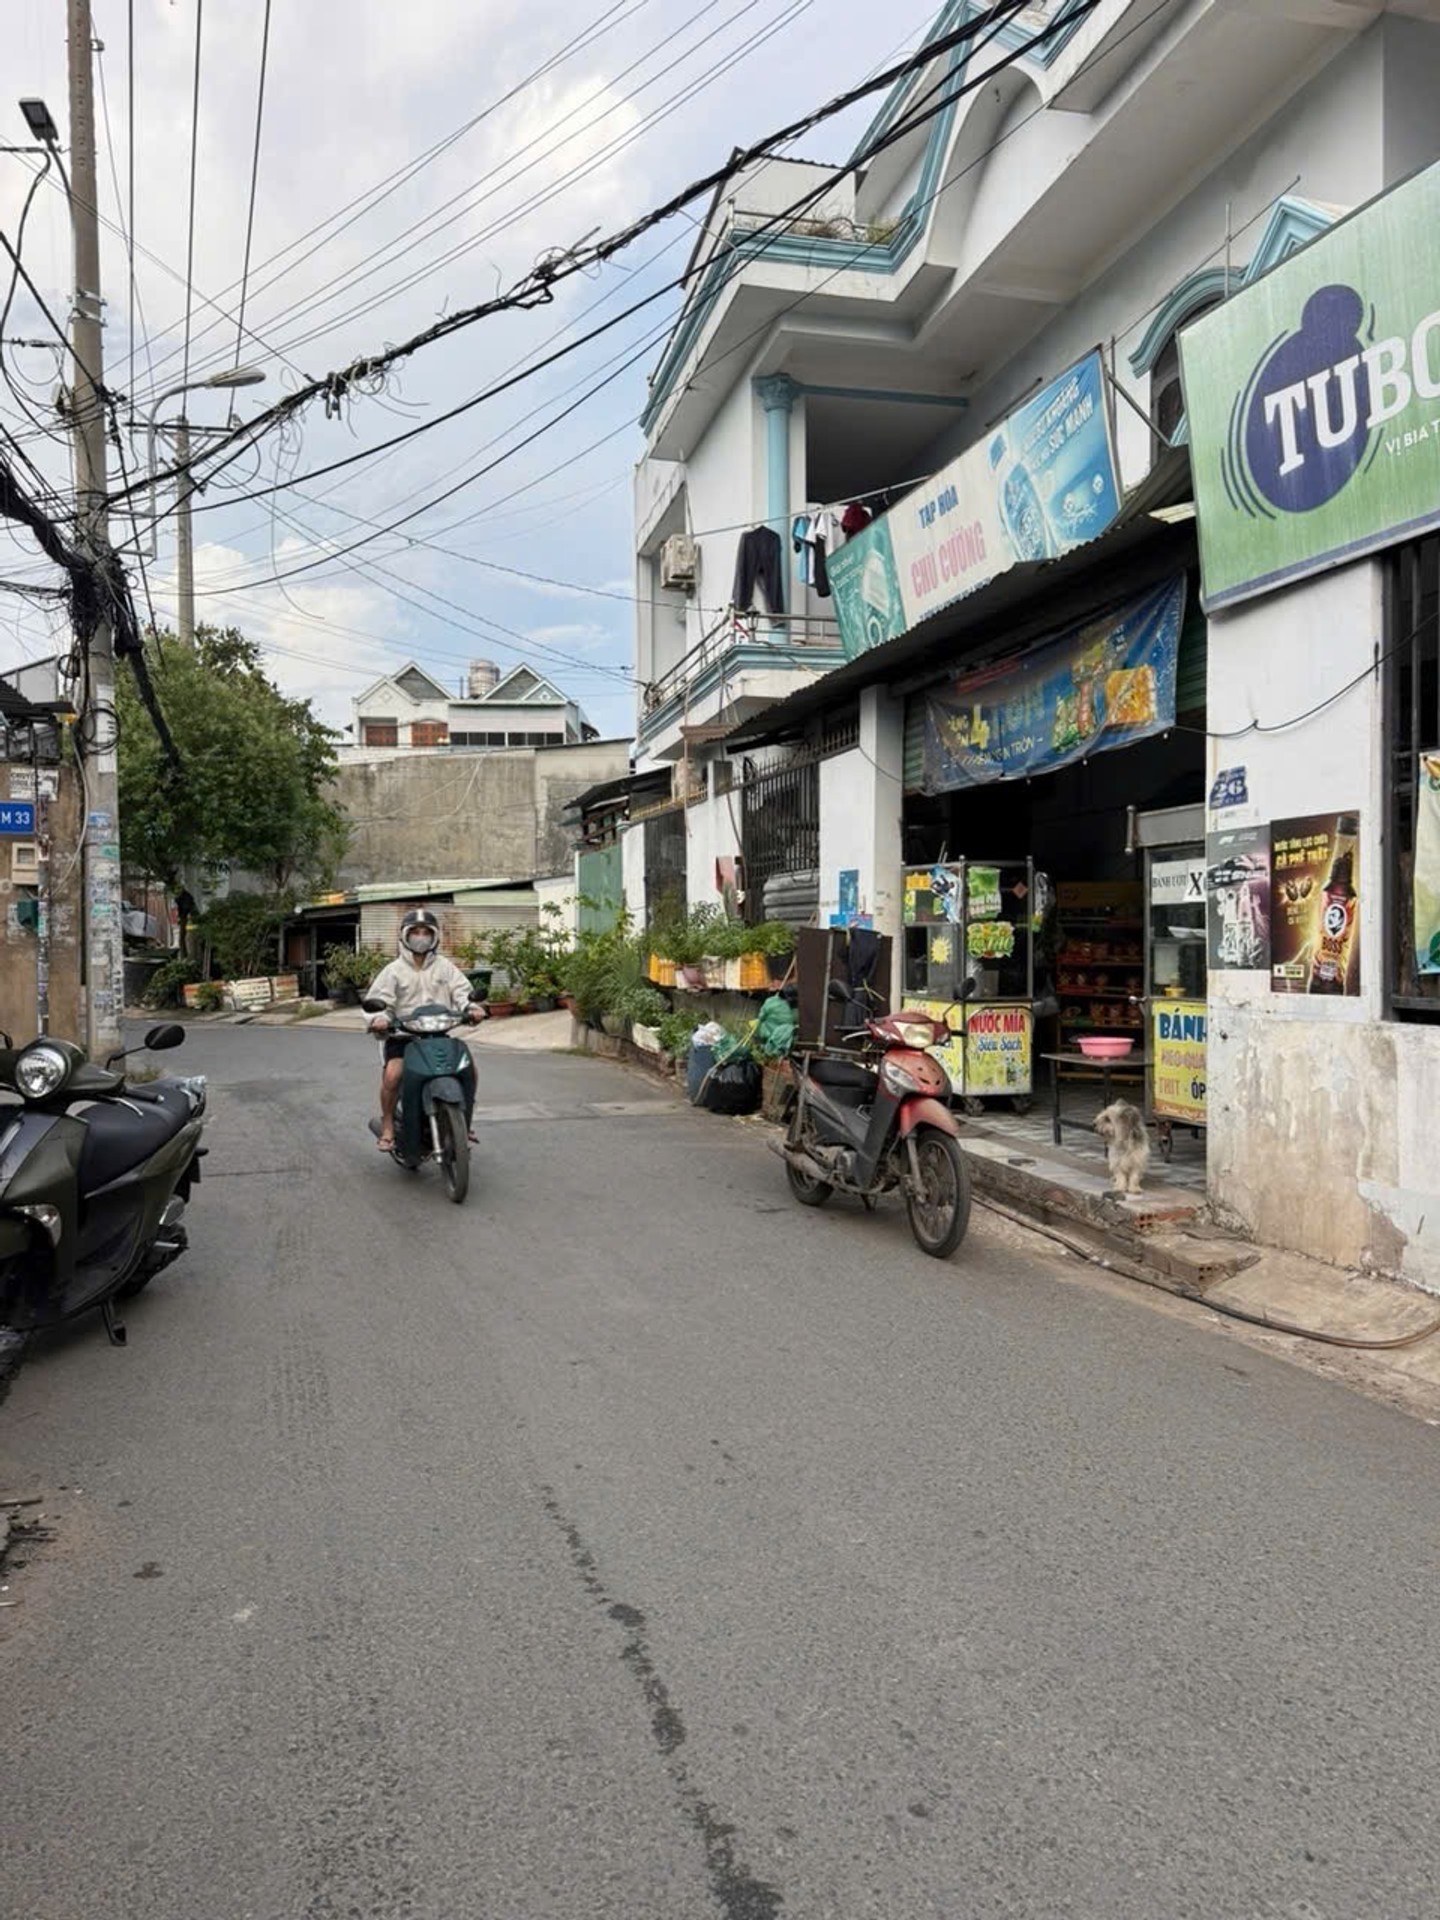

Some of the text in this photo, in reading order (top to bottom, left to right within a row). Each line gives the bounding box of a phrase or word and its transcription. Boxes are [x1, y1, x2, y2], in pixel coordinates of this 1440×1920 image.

[1385, 437, 1401, 456] VỊ
[1404, 426, 1429, 447] BIA
[1, 810, 30, 825] M 33
[1159, 1008, 1207, 1042] BÁNH
